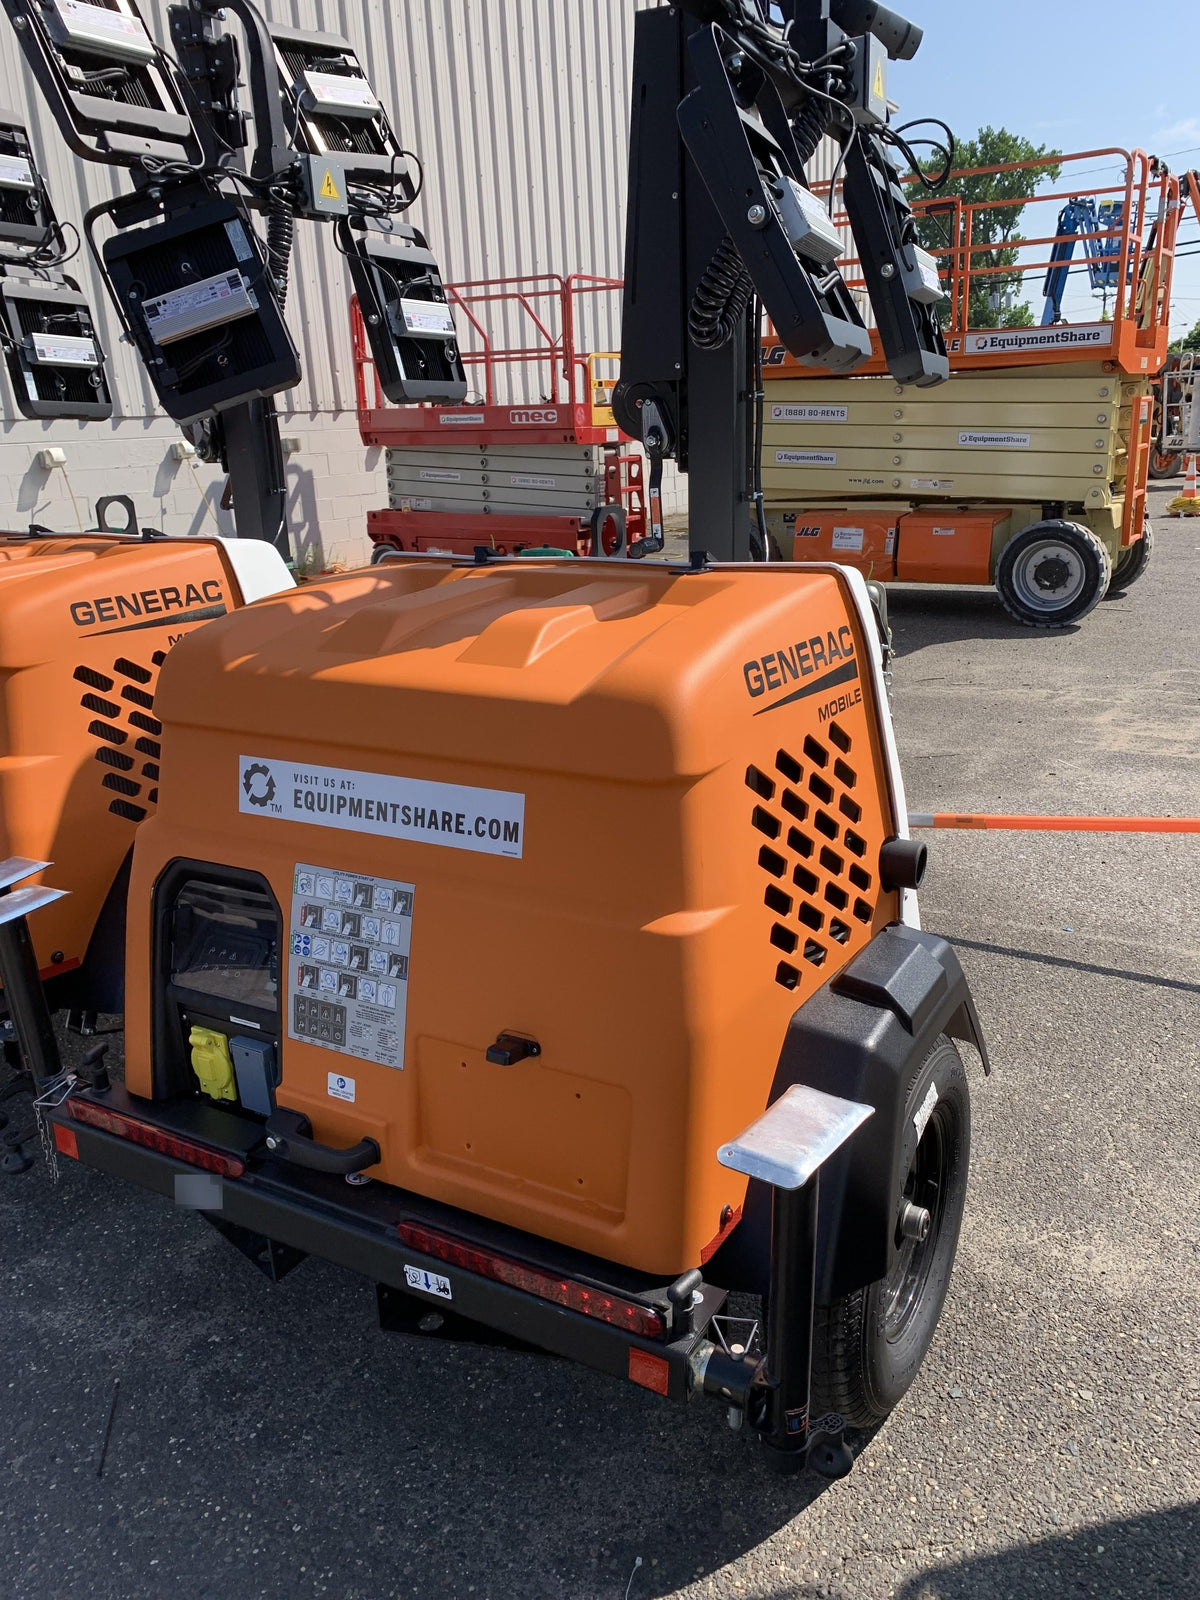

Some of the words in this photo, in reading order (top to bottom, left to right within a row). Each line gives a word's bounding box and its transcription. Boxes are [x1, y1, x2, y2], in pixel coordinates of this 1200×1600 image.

[989, 331, 1100, 348] EquipmentShare
[511, 411, 557, 422] mec
[808, 409, 846, 417] 80-RENTS
[968, 435, 1028, 445] EquipmentShare
[1168, 438, 1184, 446] JLG
[783, 454, 834, 462] EquipmentShare
[796, 527, 821, 536] JLG
[70, 580, 223, 626] GENERAC
[743, 625, 854, 698] GENERAC
[818, 688, 862, 723] MOBILE
[293, 773, 319, 786] VISIT
[323, 777, 336, 788] US
[340, 780, 355, 790] AT:
[293, 789, 520, 843] EQUIPMENTSHARE.COM
